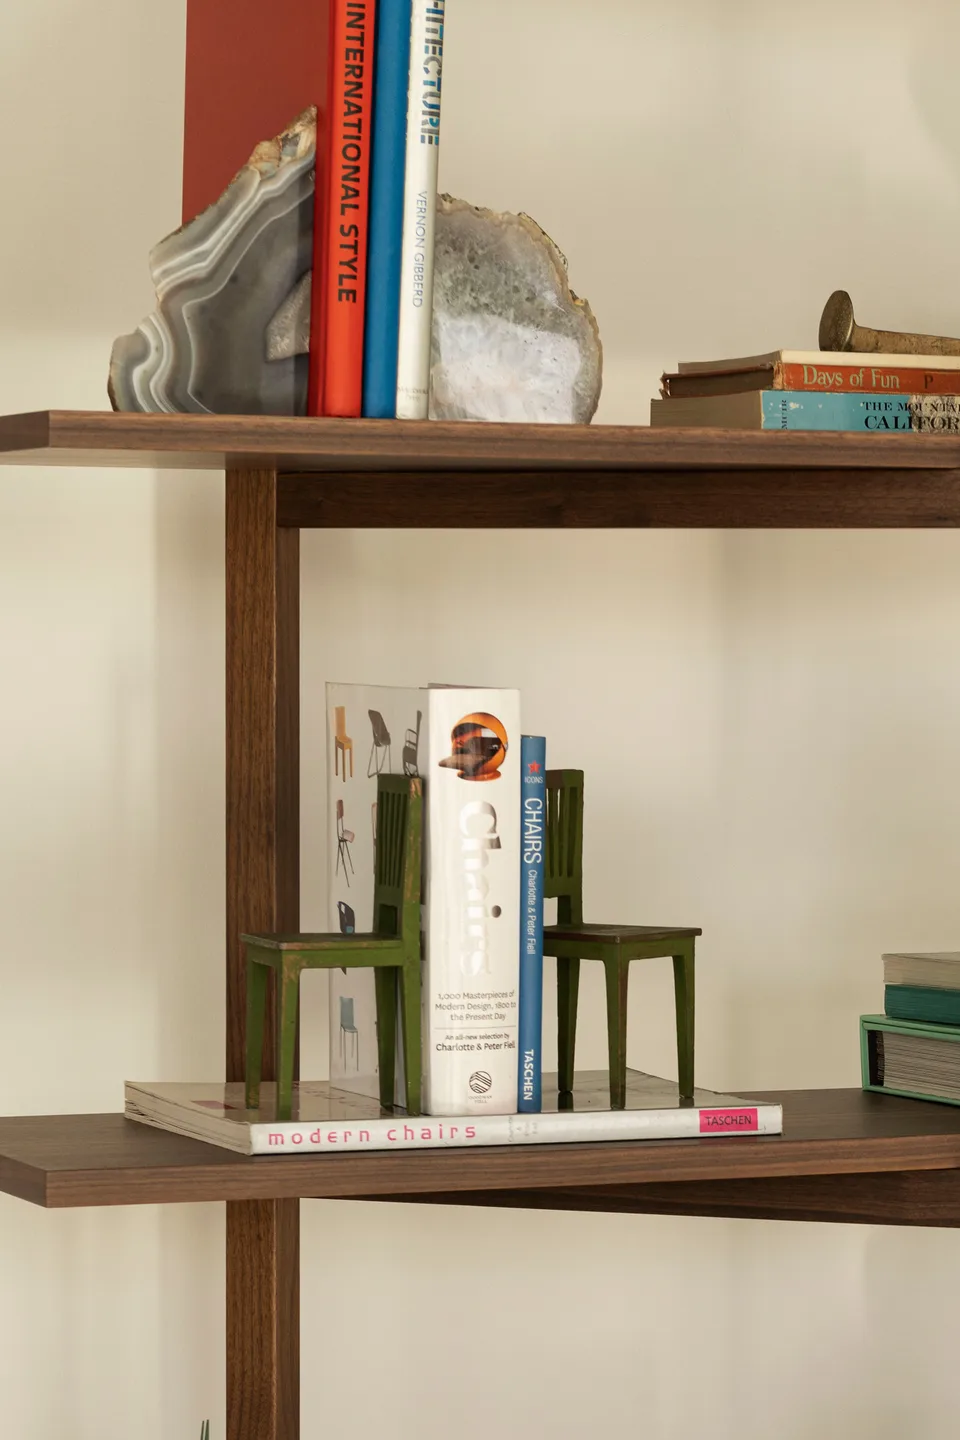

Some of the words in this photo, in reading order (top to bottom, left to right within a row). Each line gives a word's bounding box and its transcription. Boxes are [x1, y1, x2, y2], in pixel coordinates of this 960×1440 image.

[340, 2, 365, 215] INTERNATIONAL
[415, 191, 427, 247] VERNON
[338, 224, 358, 303] STYLE
[412, 252, 424, 308] GIBBERD
[803, 365, 843, 386] Days
[850, 369, 865, 387] of
[871, 368, 900, 388] Fun
[863, 401, 892, 411] THE
[524, 776, 543, 784] ICONS
[524, 798, 542, 864] CHAIRS
[527, 870, 537, 905] Charlotte
[526, 915, 536, 935] Peter
[526, 937, 536, 955] Fiell
[438, 993, 461, 1001] 1,000
[462, 991, 508, 1001] Masterpieces
[450, 1013, 464, 1021] the
[466, 1013, 492, 1021] Present
[494, 1012, 506, 1021] Day
[467, 1003, 494, 1011] Design,
[436, 1043, 475, 1051] Charlotte
[476, 1043, 482, 1051] &
[484, 1042, 503, 1050] Peter
[523, 1050, 534, 1100] TASCHEN
[705, 1115, 752, 1126] TASCHEN
[268, 1128, 371, 1146] modern
[387, 1123, 477, 1143] chairs
